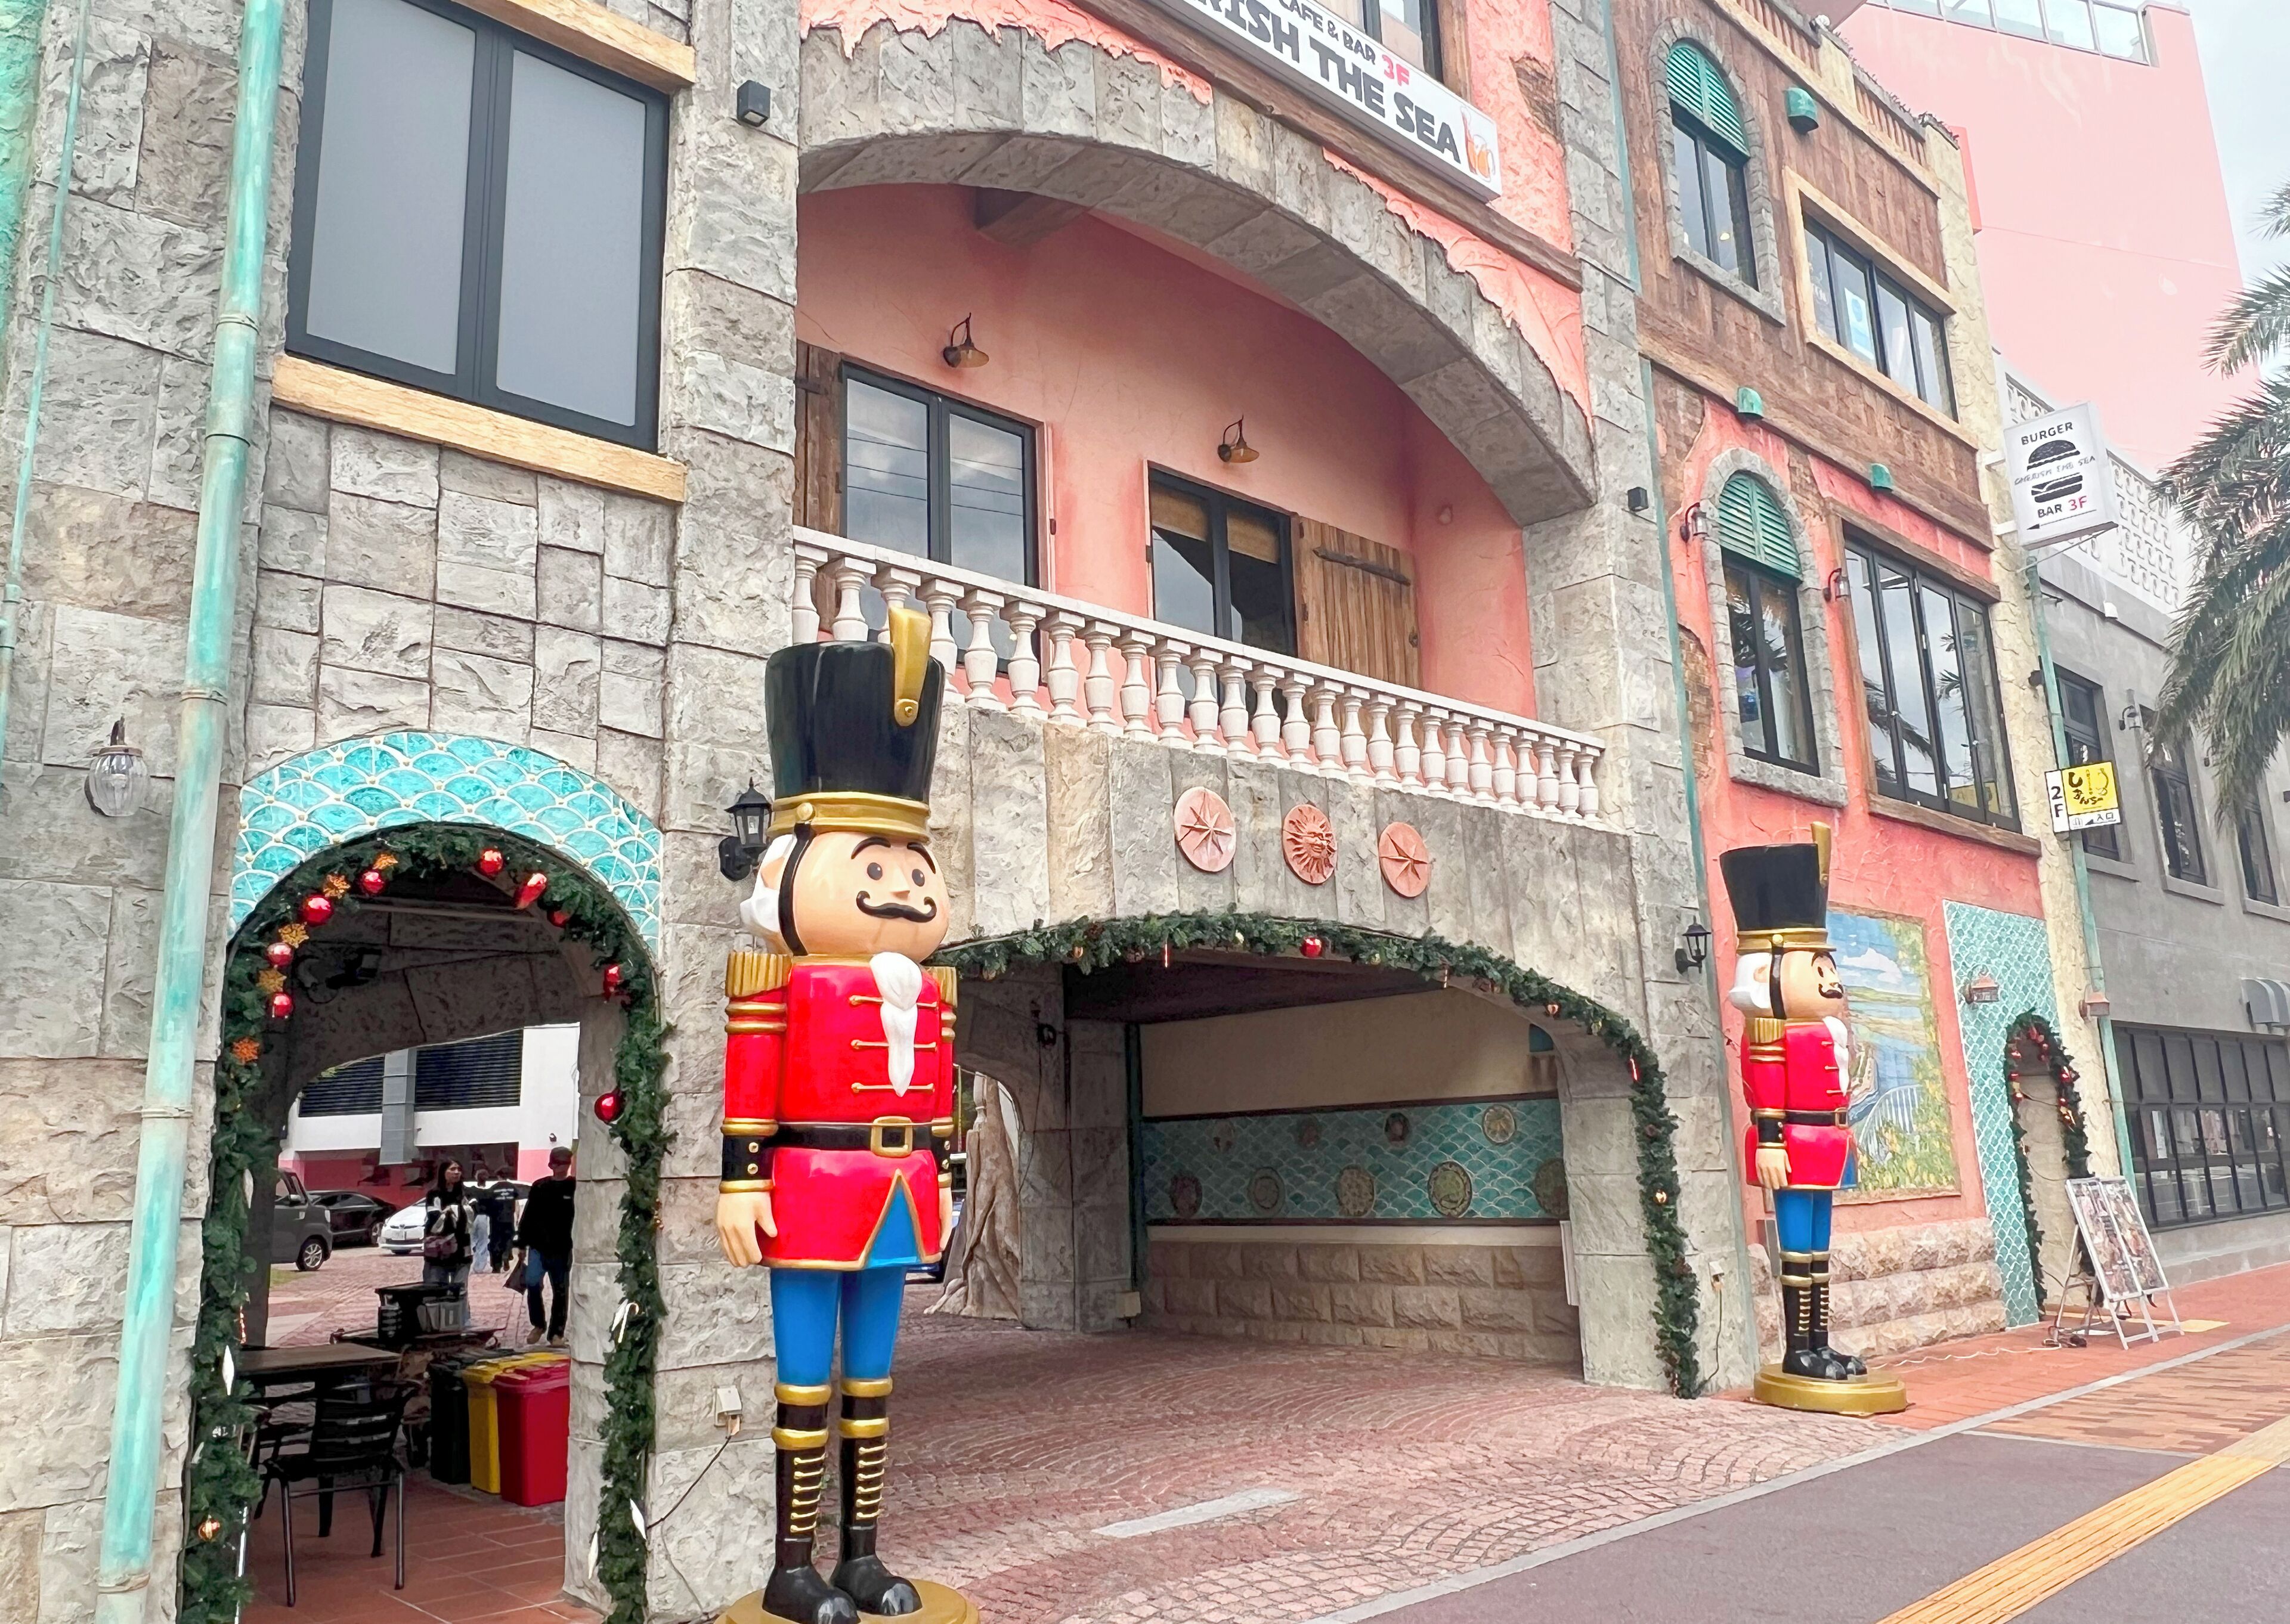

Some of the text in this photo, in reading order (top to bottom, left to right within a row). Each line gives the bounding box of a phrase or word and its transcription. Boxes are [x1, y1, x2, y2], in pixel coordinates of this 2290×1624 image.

[1327, 20, 1339, 41] &
[1342, 30, 1376, 64] BAR
[1382, 54, 1410, 86] 3F
[1197, 0, 1461, 164] ISH THE SEA
[2020, 422, 2074, 446] BURGER
[2078, 455, 2096, 466] SEA
[2037, 495, 2087, 518] BAR 3F
[2097, 811, 2114, 822] 入口
